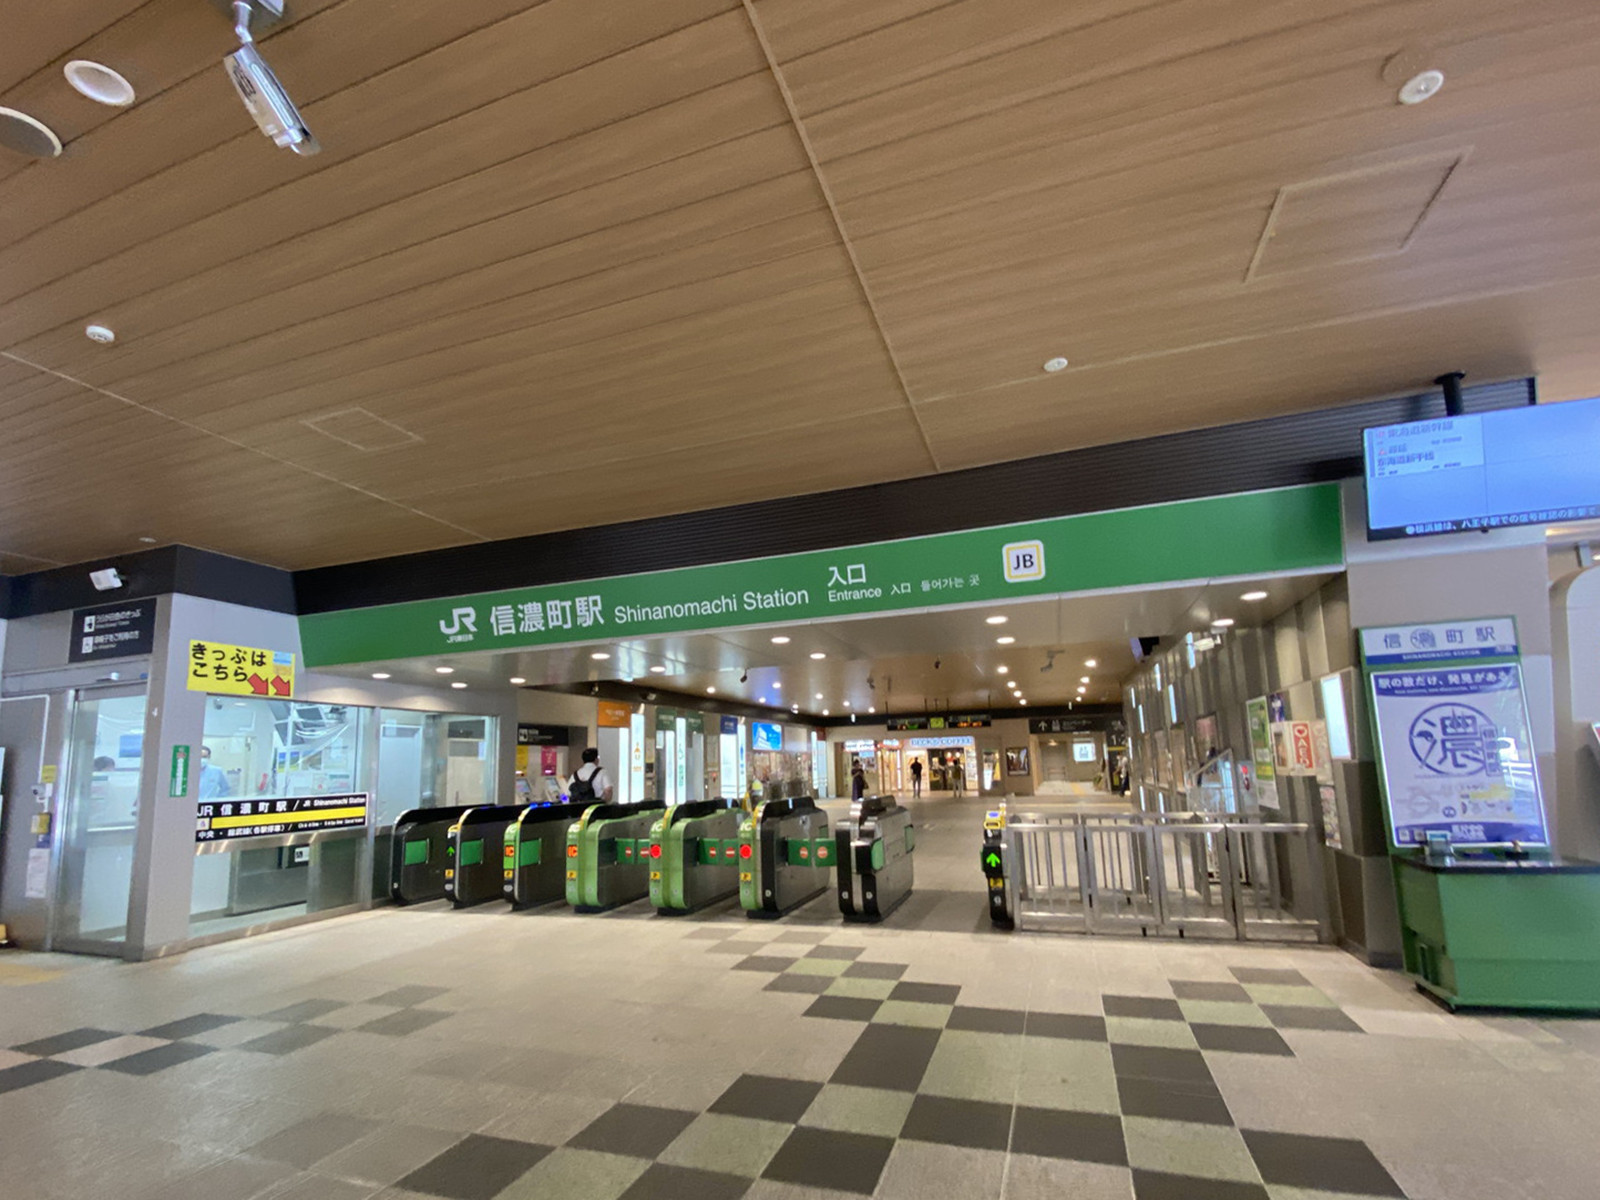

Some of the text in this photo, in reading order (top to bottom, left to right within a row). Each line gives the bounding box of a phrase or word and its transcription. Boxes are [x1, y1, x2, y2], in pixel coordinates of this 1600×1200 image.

[1013, 553, 1035, 570] JB
[827, 563, 867, 588] 入口
[827, 587, 883, 603] Entrance
[890, 582, 912, 596] 入口
[920, 577, 965, 593] 들어가는
[439, 588, 810, 637] JR 信濃町駅 Shinanomachi Station
[192, 642, 266, 667] きっぷは
[193, 661, 248, 682] こちら
[196, 805, 213, 817] JR
